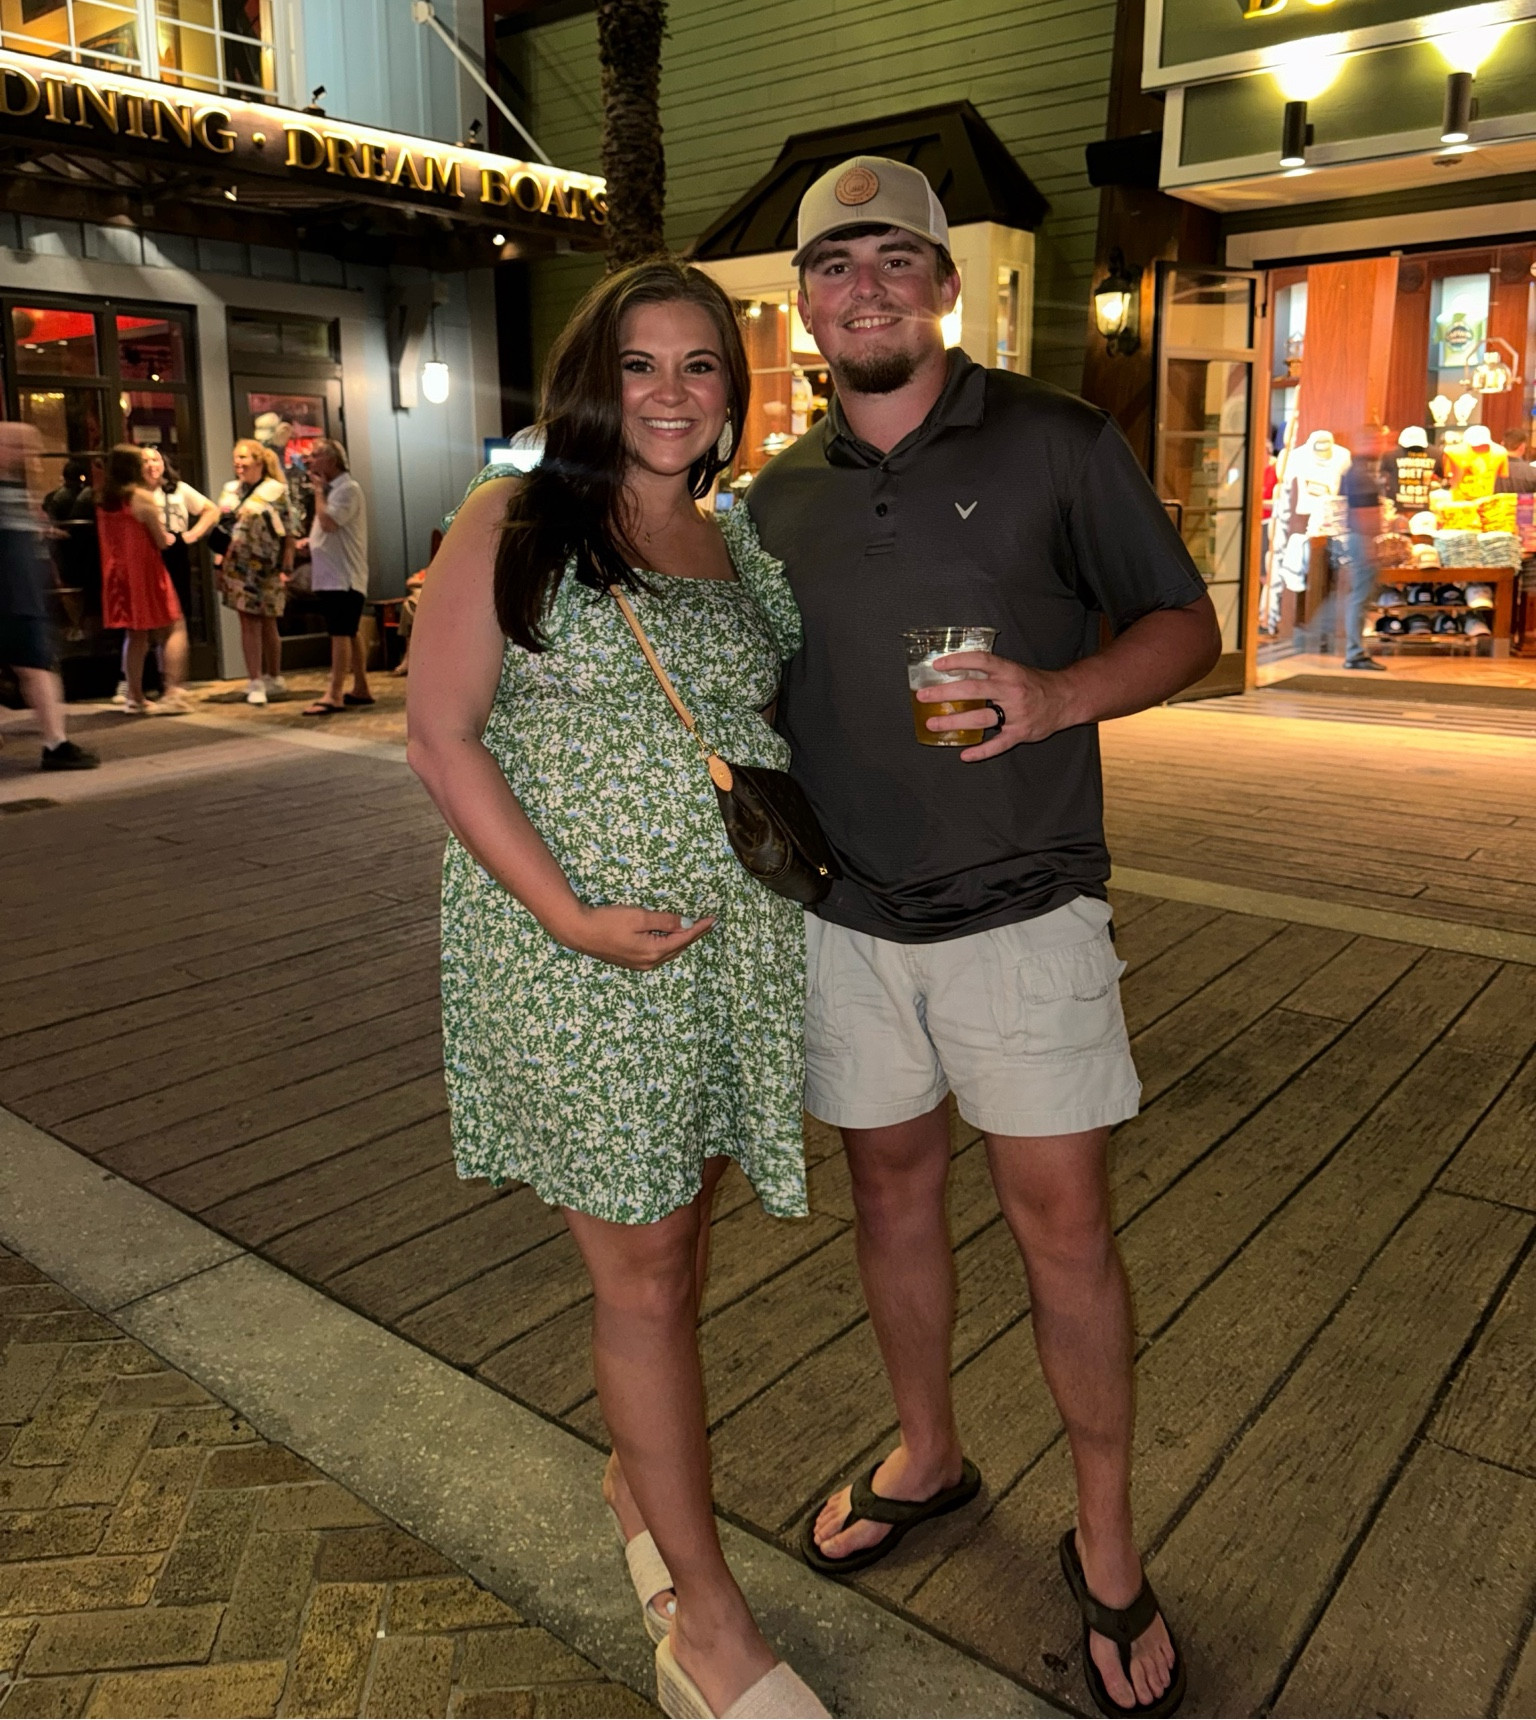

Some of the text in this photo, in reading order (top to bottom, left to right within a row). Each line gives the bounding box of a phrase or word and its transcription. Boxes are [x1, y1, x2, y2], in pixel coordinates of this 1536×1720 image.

[0, 62, 609, 226] DINING DREAM BOATS
